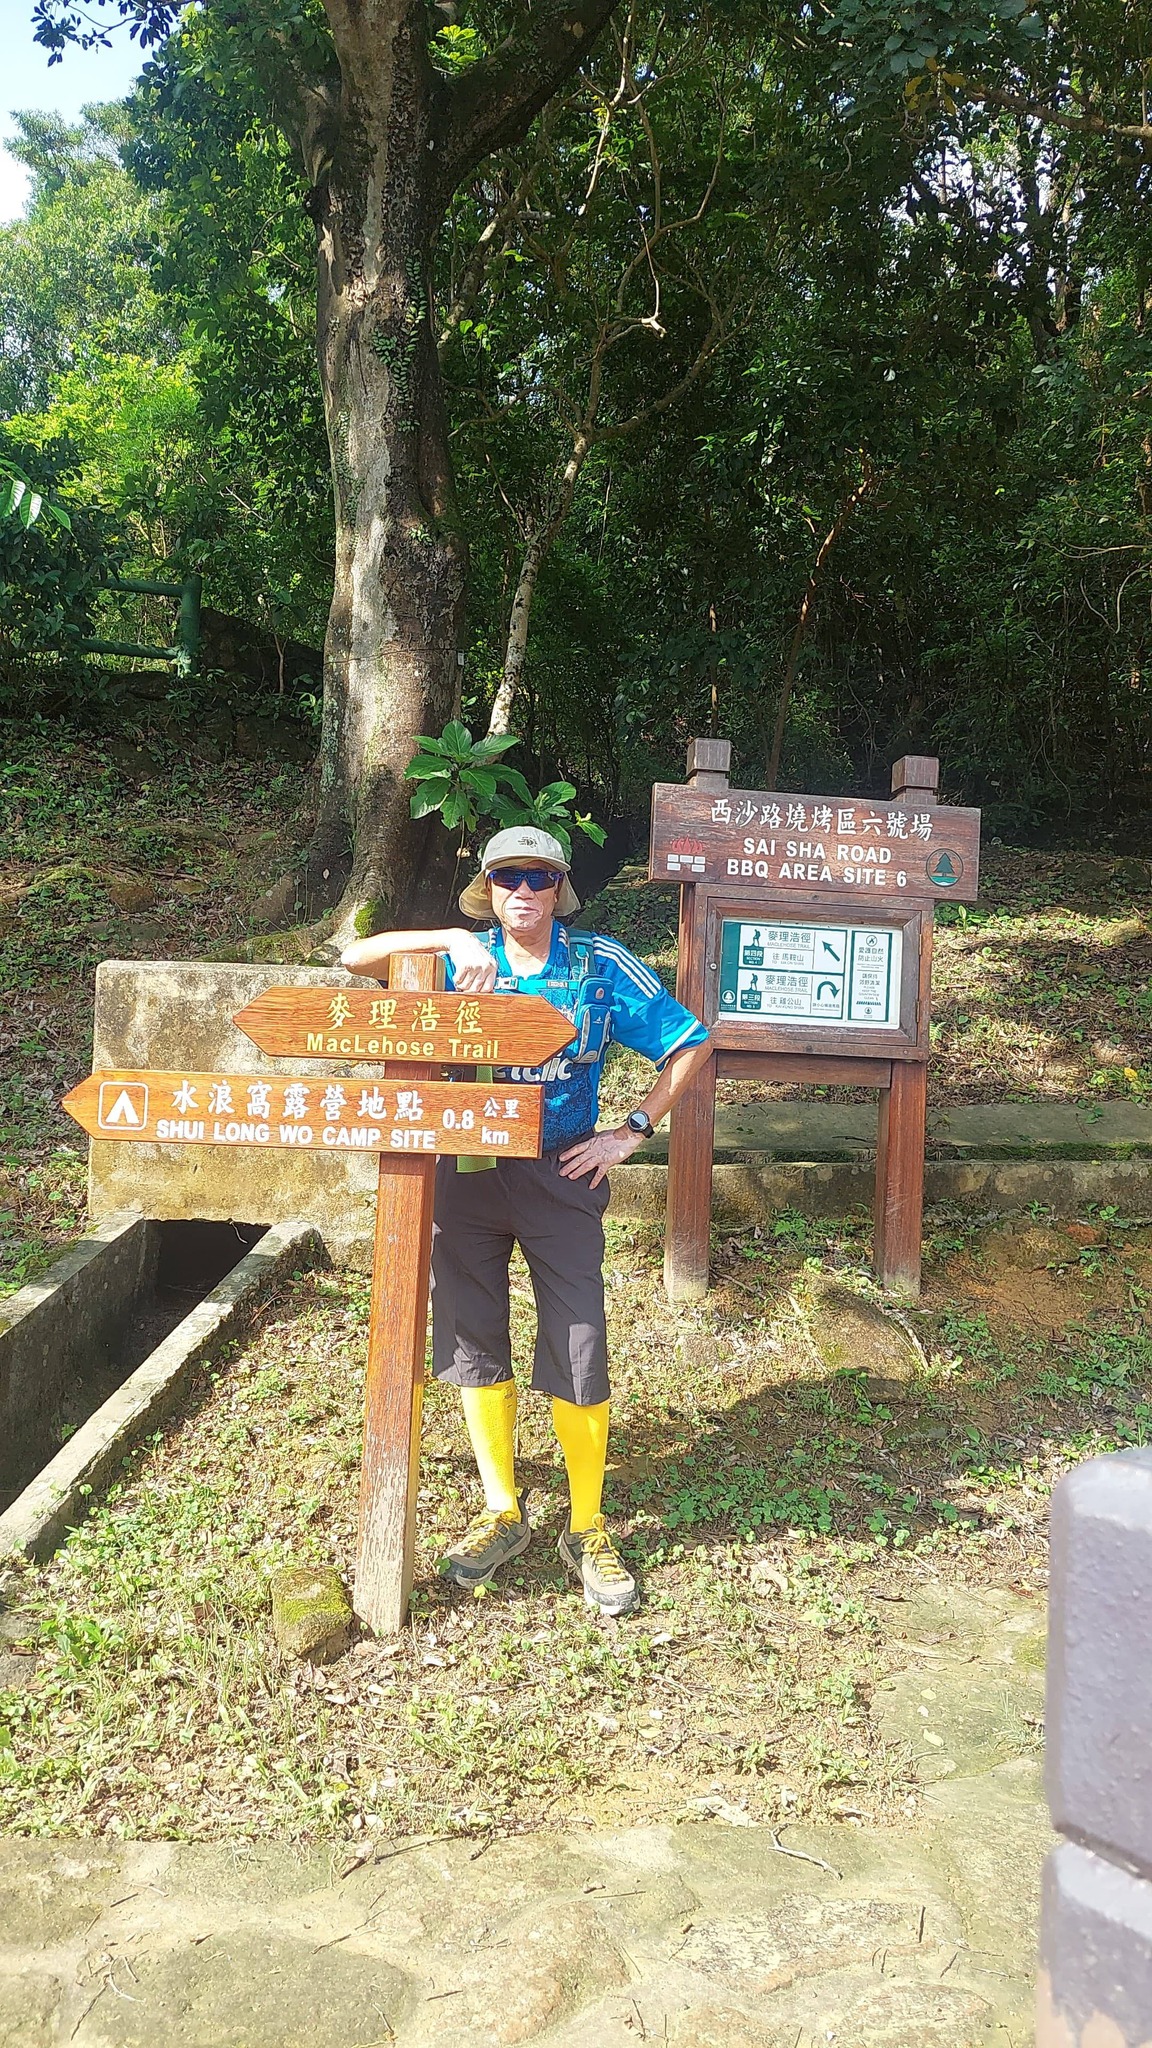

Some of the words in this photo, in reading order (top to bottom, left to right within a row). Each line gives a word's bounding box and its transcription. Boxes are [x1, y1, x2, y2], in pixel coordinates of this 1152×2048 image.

[710, 798, 934, 841] 西沙路燒烤區六號場
[743, 838, 776, 857] SAI
[785, 841, 826, 860] SHA
[837, 844, 892, 864] ROAD
[727, 859, 769, 879] BBQ
[779, 863, 832, 882] AREA
[843, 867, 886, 886] SITE
[896, 870, 907, 888] 6
[768, 930, 811, 943] 麥理浩徑
[765, 974, 809, 987] 麥理浩徑
[326, 992, 484, 1034] 麥理浩徑
[306, 1033, 435, 1056] MacLehose
[449, 1038, 499, 1059] Trail
[171, 1079, 425, 1122] 水浪窩露營地點
[442, 1108, 475, 1130] 0.8
[483, 1096, 520, 1119] 公里
[156, 1119, 205, 1140] SHUI
[213, 1121, 270, 1143] LONG
[279, 1124, 313, 1145] WO
[322, 1126, 381, 1147] CAMP
[390, 1129, 436, 1149] SITE
[481, 1125, 510, 1145] km
